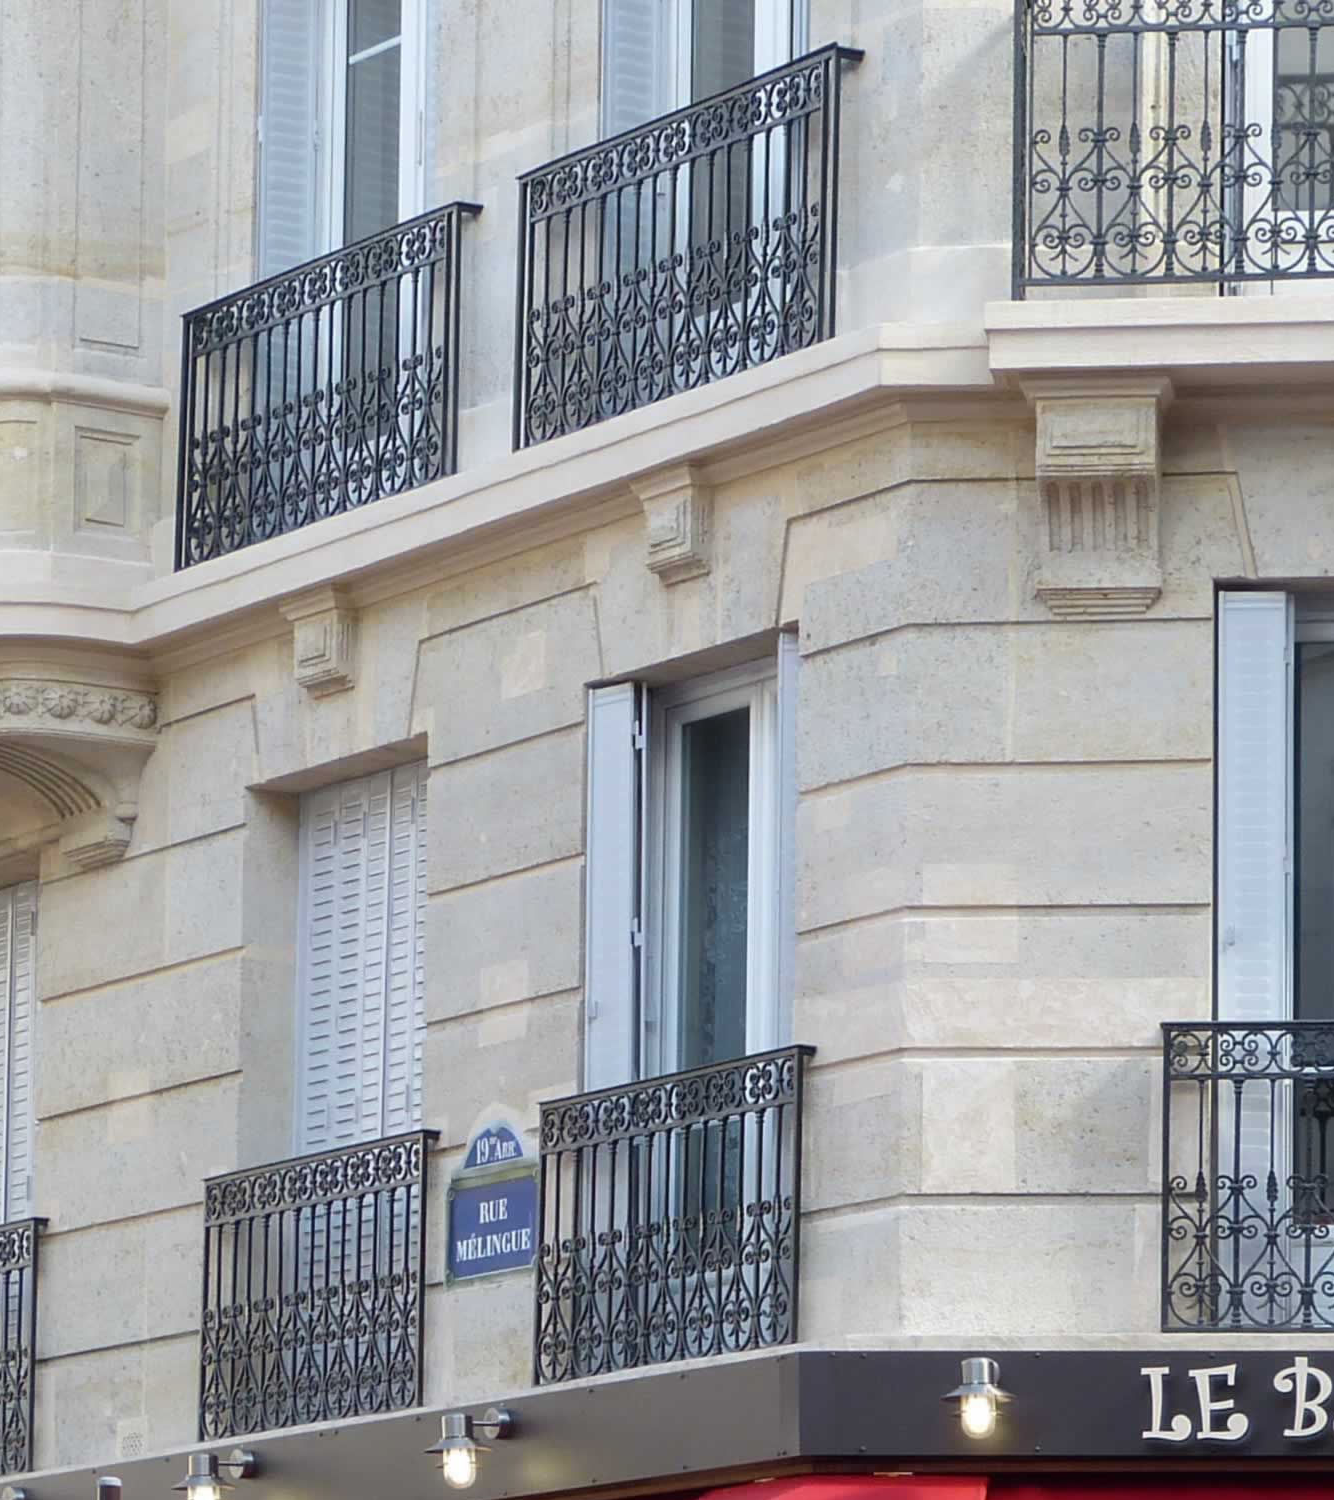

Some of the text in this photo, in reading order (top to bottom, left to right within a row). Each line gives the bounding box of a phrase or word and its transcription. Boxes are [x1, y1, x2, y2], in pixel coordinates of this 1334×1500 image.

[479, 1198, 508, 1224] RUE
[455, 1228, 531, 1262] MÉLINGUE
[1141, 1363, 1249, 1442] LE
